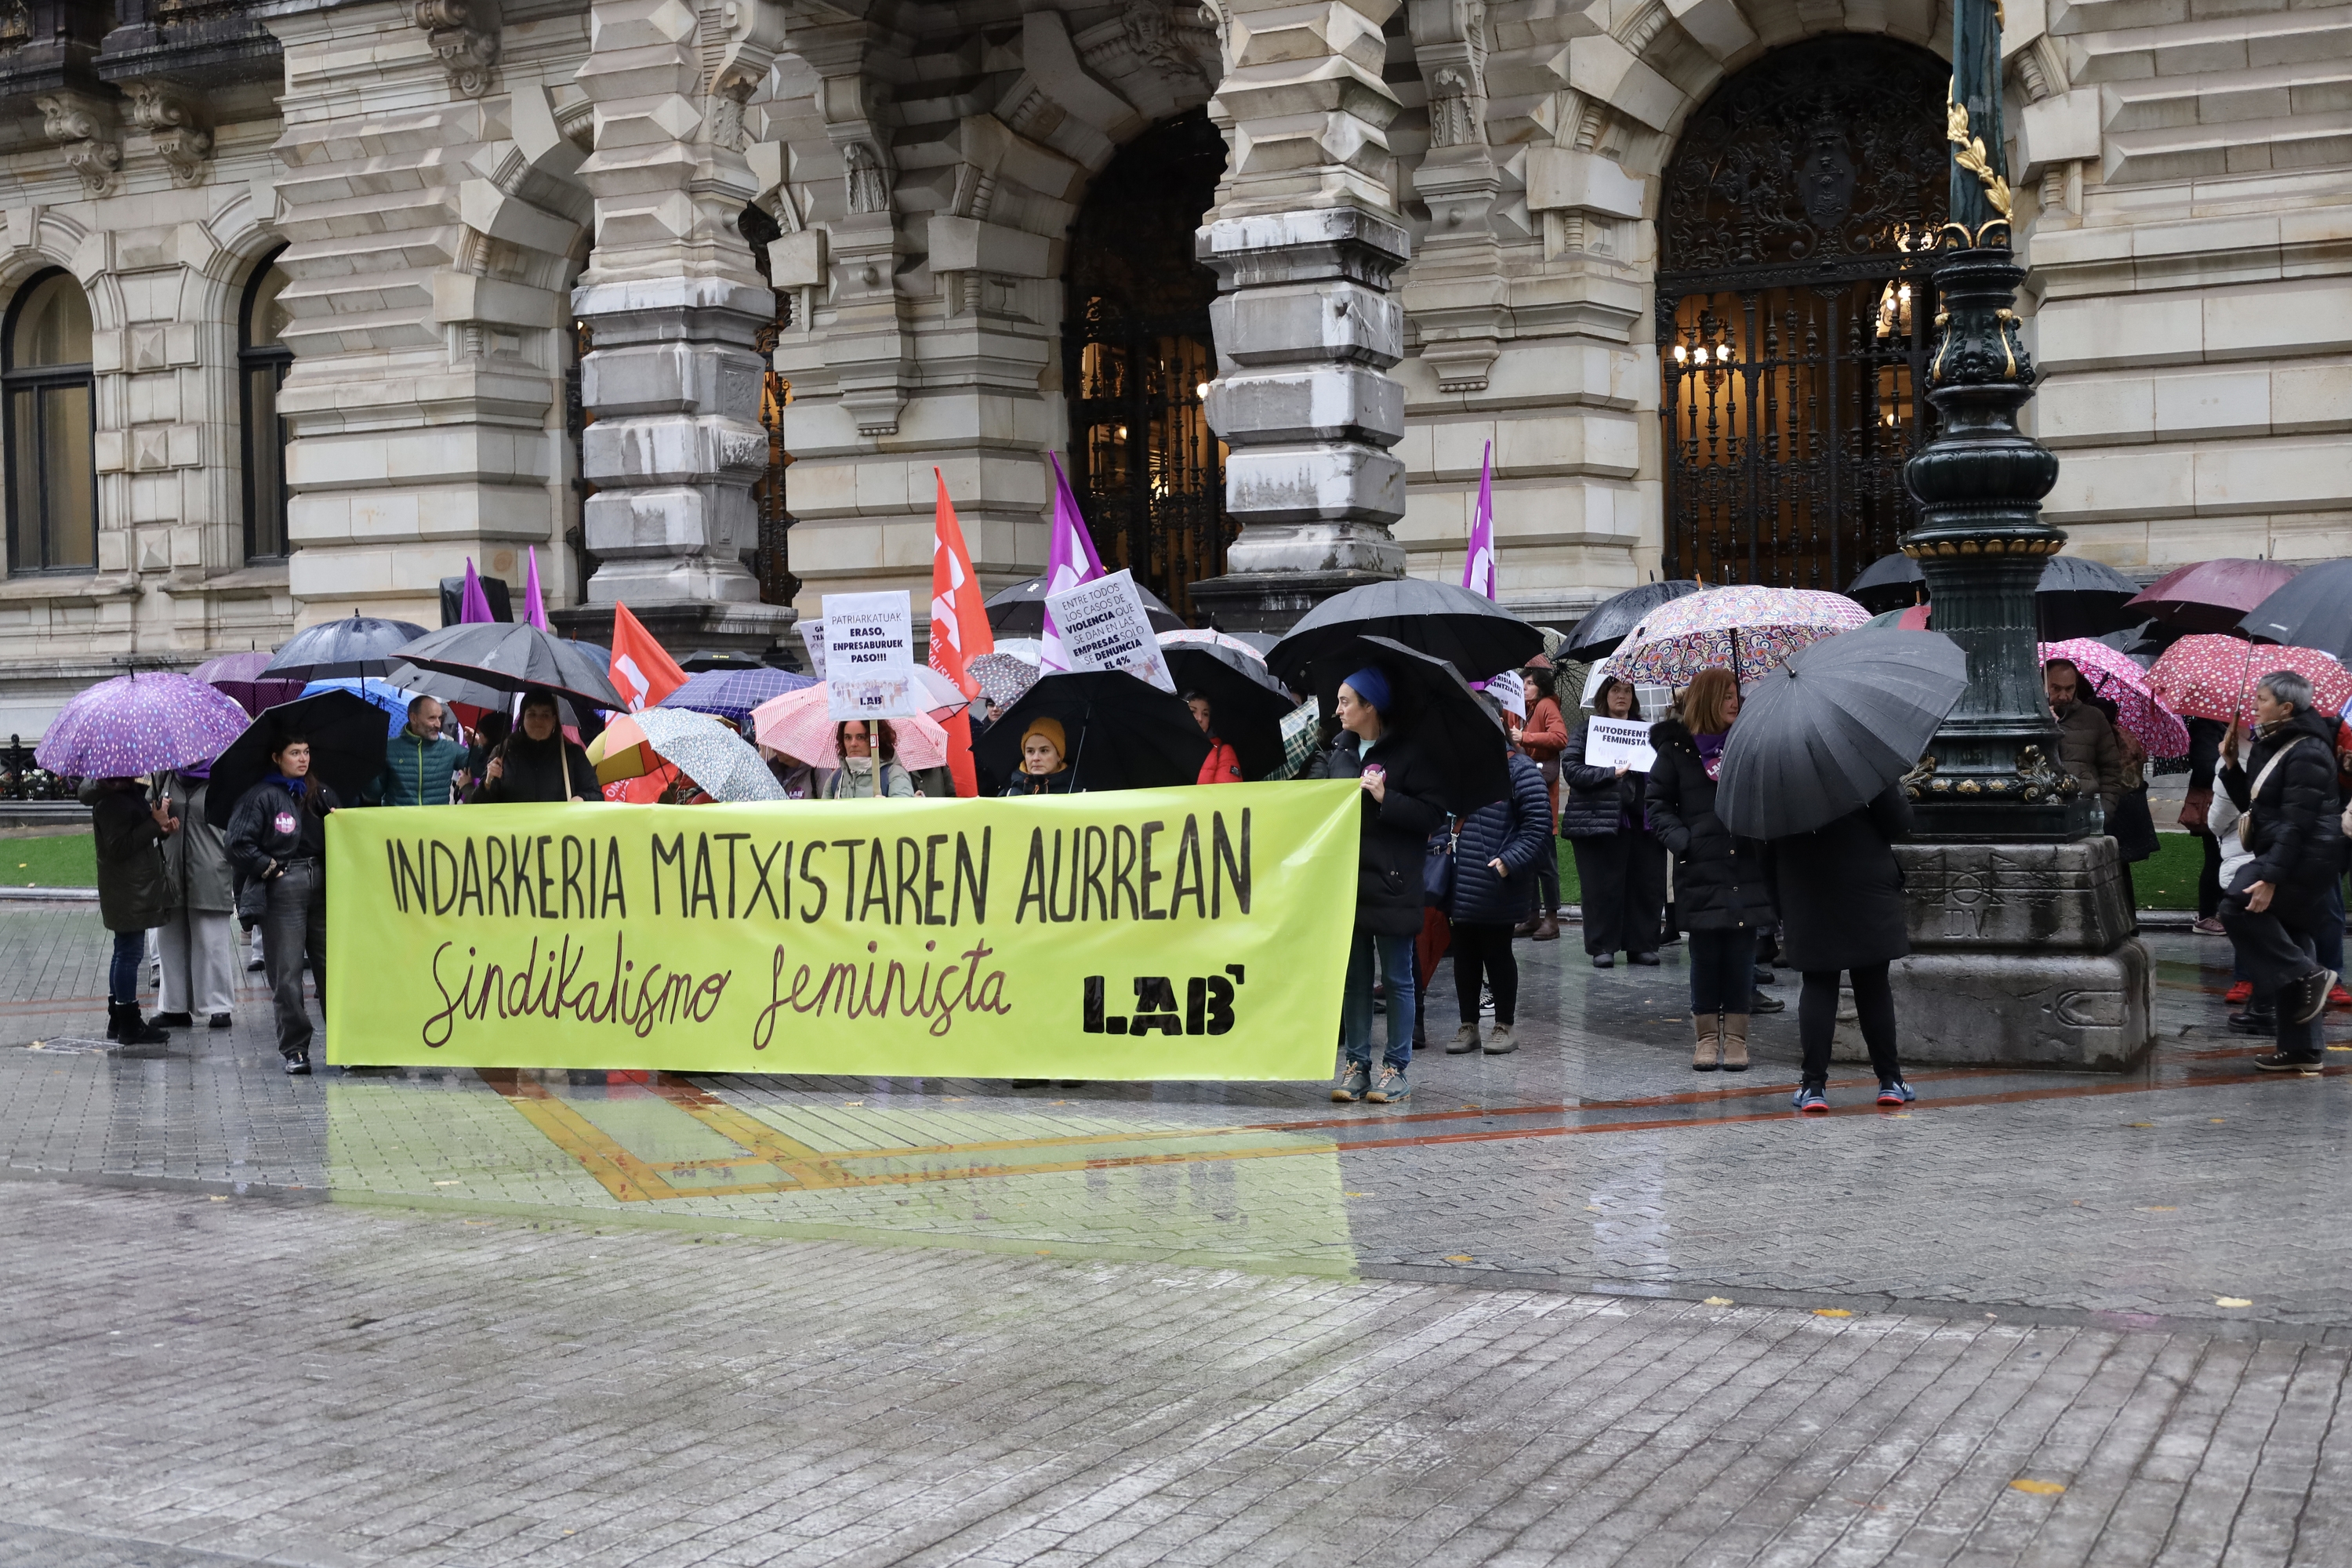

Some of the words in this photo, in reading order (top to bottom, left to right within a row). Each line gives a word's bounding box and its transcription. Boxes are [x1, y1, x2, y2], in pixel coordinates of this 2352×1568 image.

[1062, 594, 1088, 611] ENTRE
[1088, 583, 1120, 601] TODOS
[1065, 610, 1083, 622] LOS
[1083, 598, 1112, 615] CASOS
[1113, 593, 1126, 605] DE
[832, 612, 902, 625] PATRIARKATUAK
[850, 626, 885, 637] ERASO,
[1065, 611, 1116, 634] VIOLENCIA
[1115, 603, 1135, 617] QUE
[1073, 634, 1085, 644] SE
[1085, 626, 1105, 641] DAN
[1106, 623, 1119, 633] EN
[1119, 616, 1135, 629] LAS
[833, 640, 903, 652] ENPRESABURUEK
[1073, 634, 1120, 657] EMPRESAS
[1120, 625, 1145, 641] SOLO
[1083, 655, 1095, 666] SE
[1094, 638, 1143, 662] DENUNCIA
[851, 653, 887, 663] PASO!!!
[1104, 661, 1116, 670] EL
[1116, 655, 1131, 666] 4%
[1602, 735, 1646, 746] FEMINISTA
[386, 833, 626, 920] INDARKERIA
[652, 825, 992, 927] MATXISTAREN
[1014, 807, 1252, 925] AURREAN
[1083, 964, 1246, 1036] LAB
